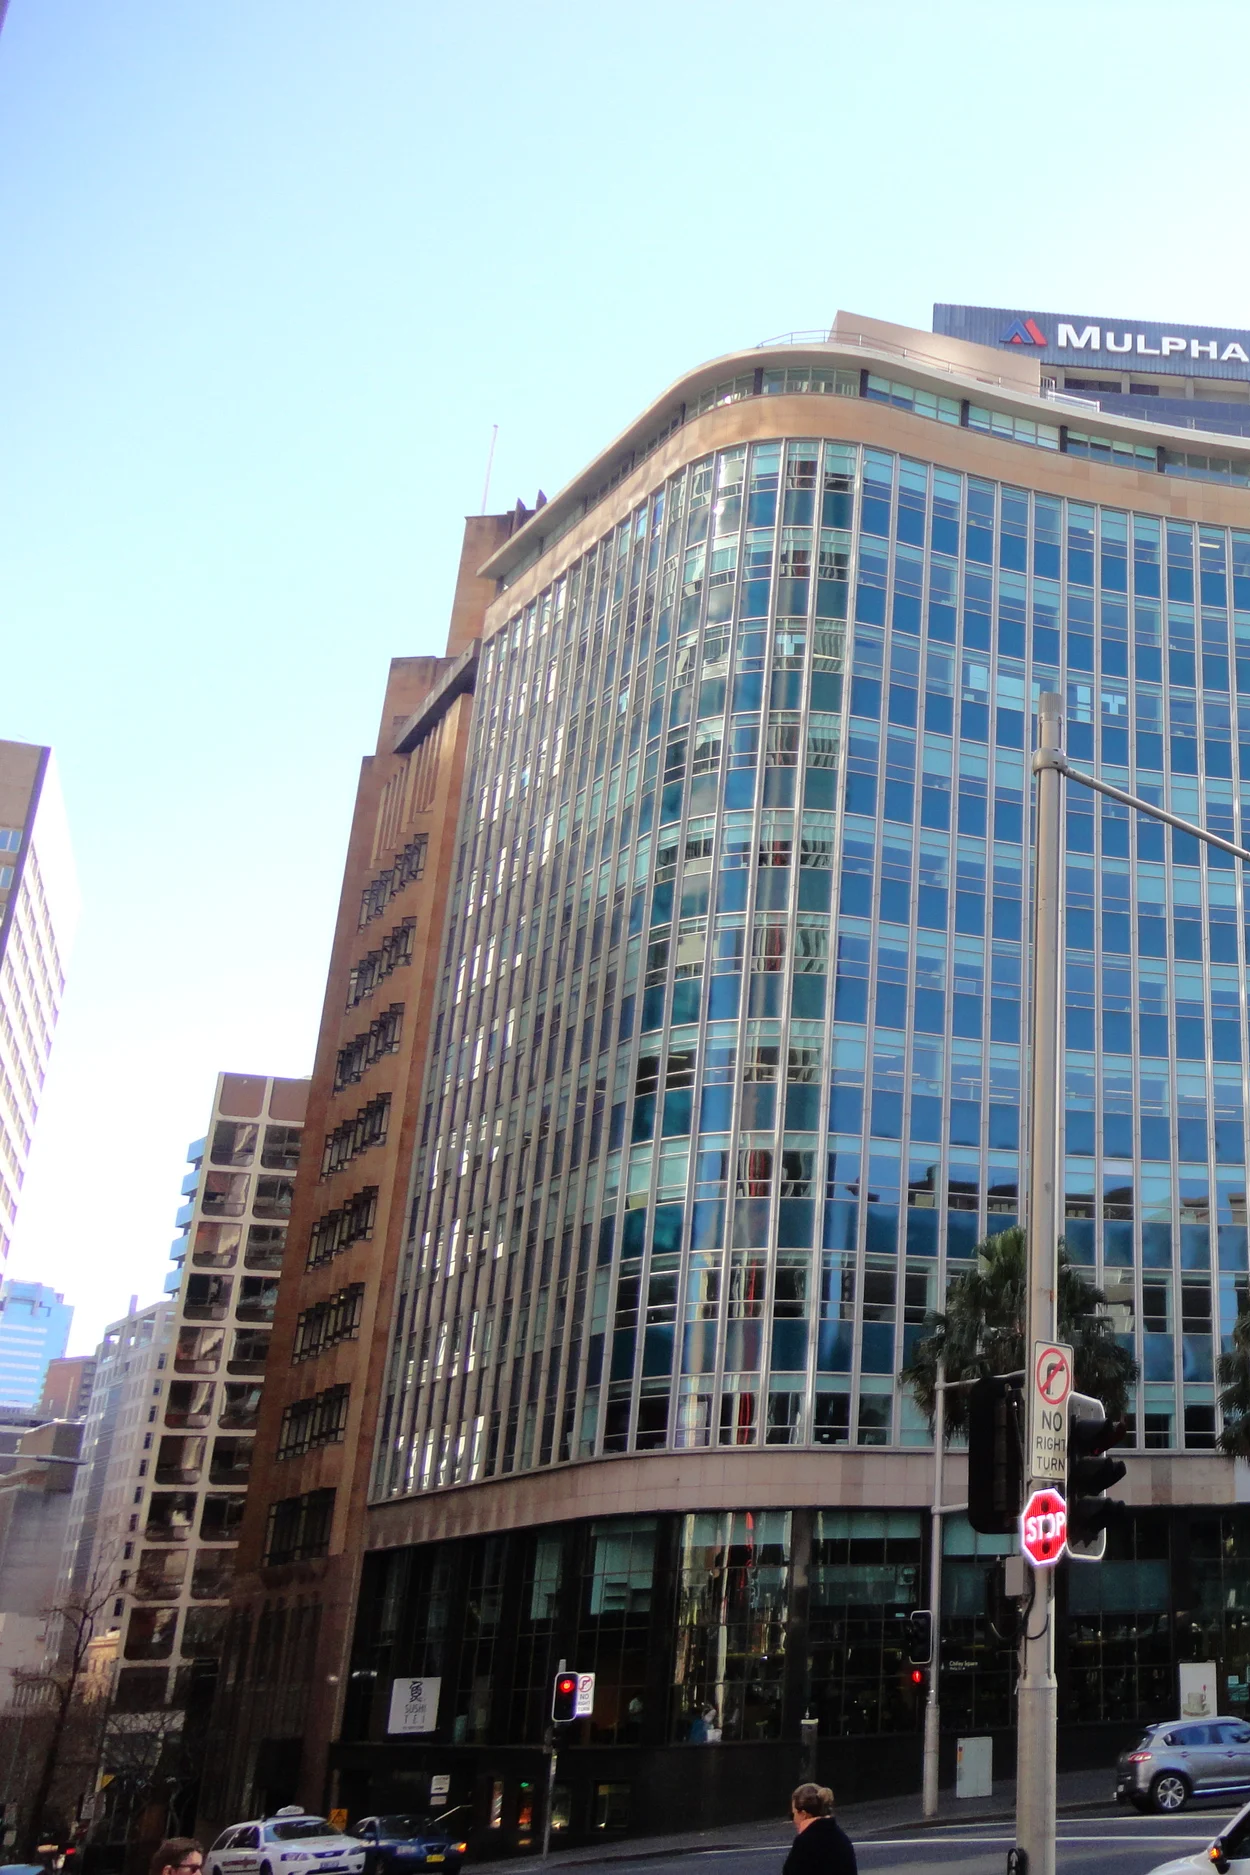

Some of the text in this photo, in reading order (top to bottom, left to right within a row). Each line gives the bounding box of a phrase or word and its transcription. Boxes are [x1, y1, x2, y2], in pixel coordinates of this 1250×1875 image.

[1057, 1323, 1250, 1363] MULPHA
[1041, 1409, 1063, 1432] NO
[1036, 1436, 1066, 1452] RIGHT
[1036, 1455, 1065, 1472] TURN
[1026, 1511, 1066, 1542] STOP
[404, 1703, 427, 1714] SUSHI
